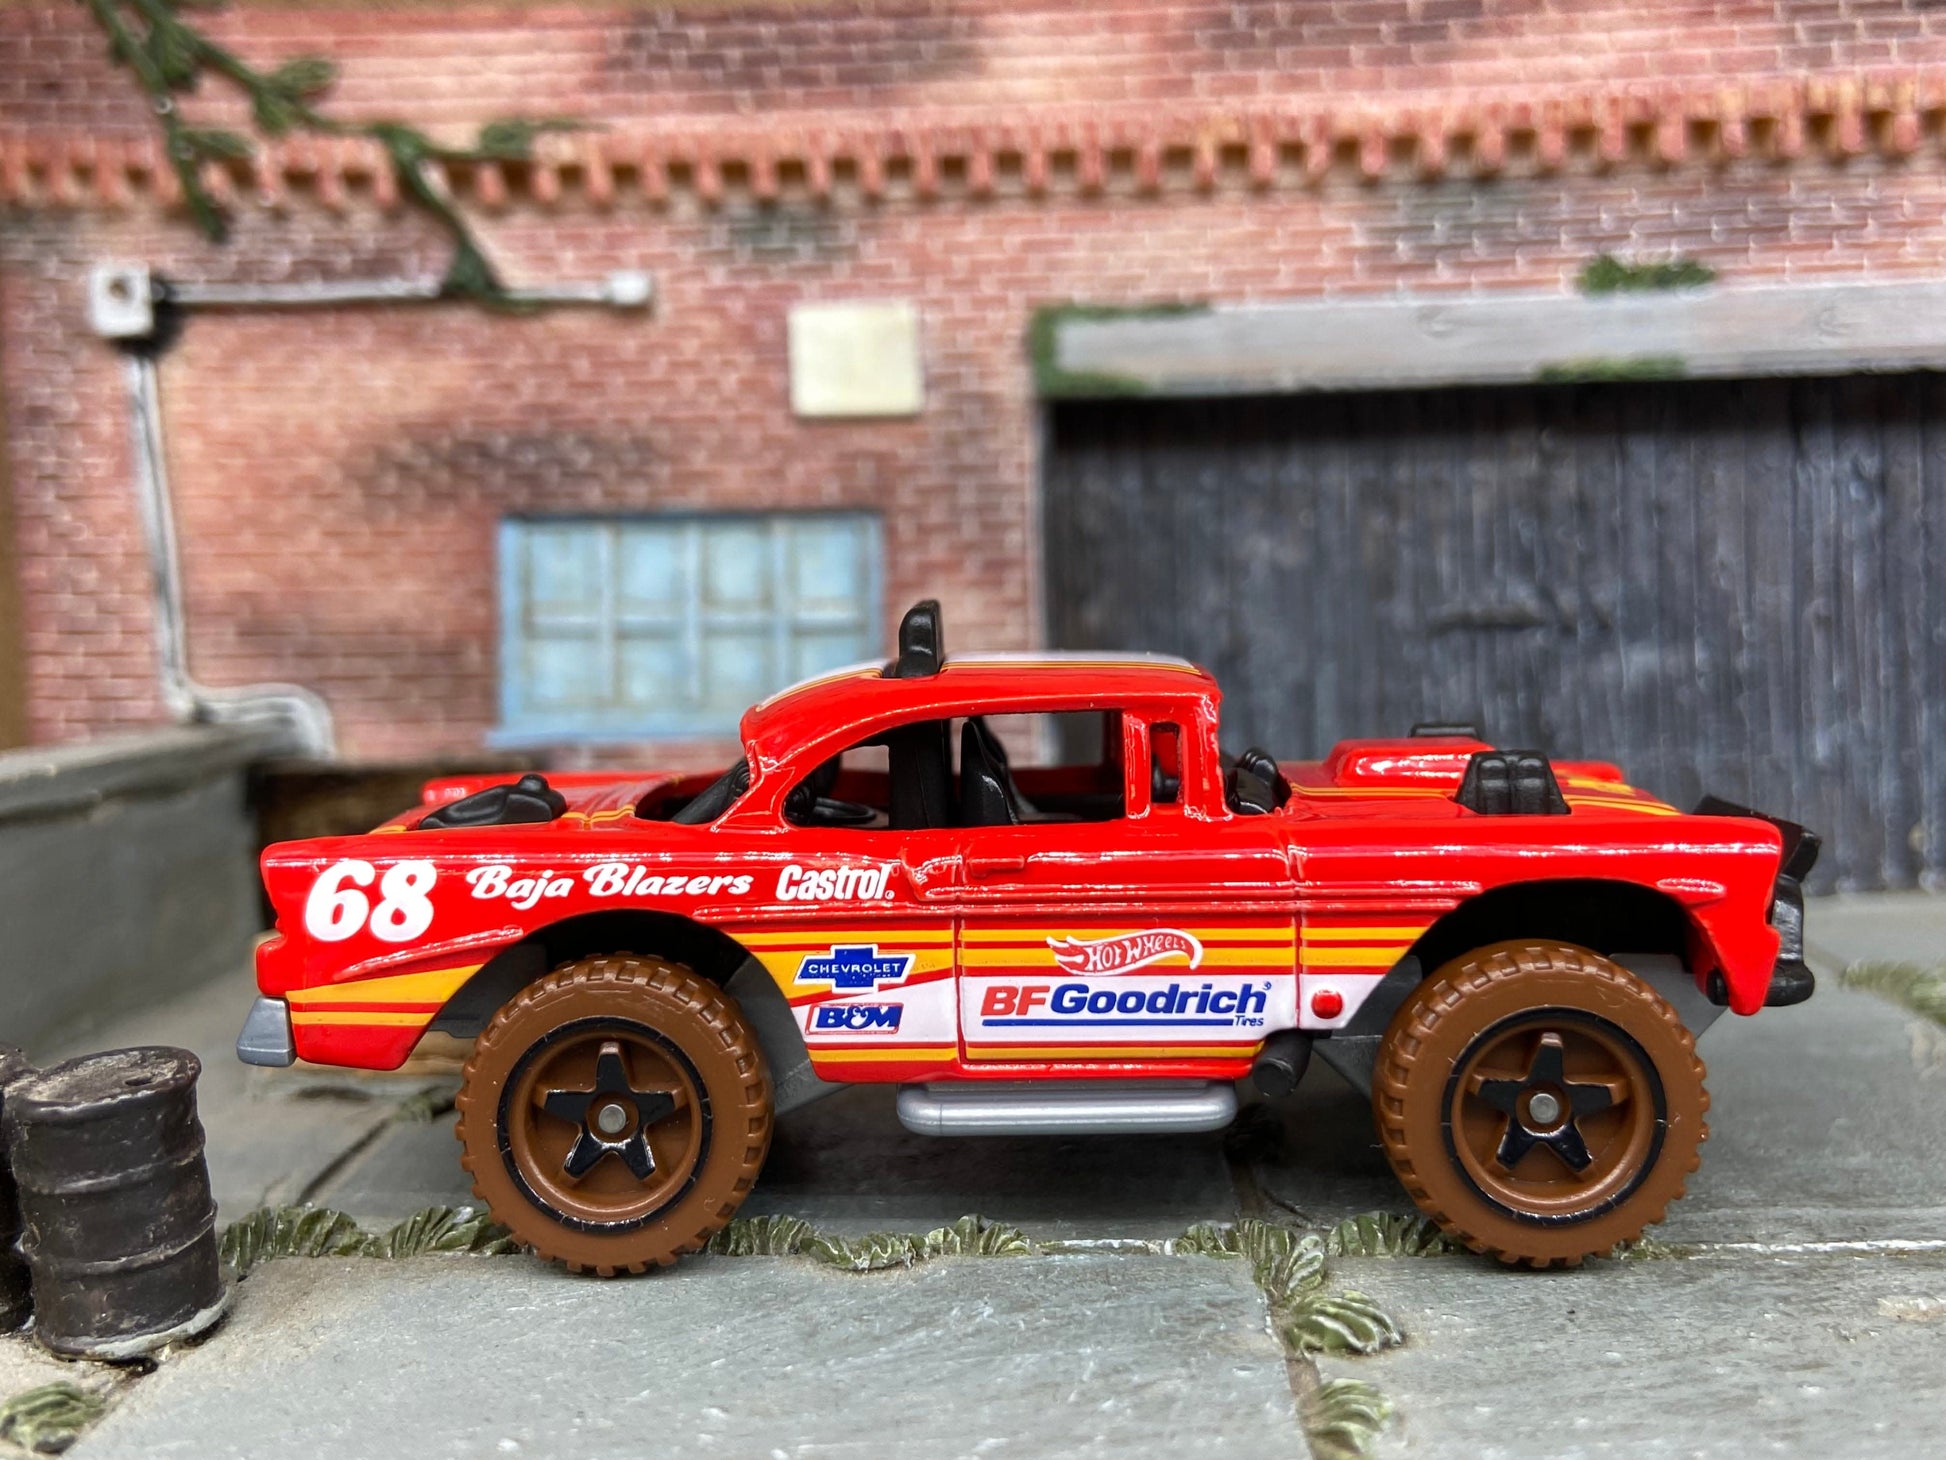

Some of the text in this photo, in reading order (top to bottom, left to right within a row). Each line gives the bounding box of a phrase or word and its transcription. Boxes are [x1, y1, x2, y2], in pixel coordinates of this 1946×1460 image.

[465, 863, 753, 910] Baja Blazers
[775, 864, 891, 900] Castrol
[305, 860, 436, 942] 68
[808, 963, 900, 974] CHEVROLET
[1083, 945, 1122, 971] HOT
[980, 983, 1267, 1016] BFGoodrich
[815, 1005, 903, 1030] B&M
[1235, 1015, 1264, 1027] Tires
